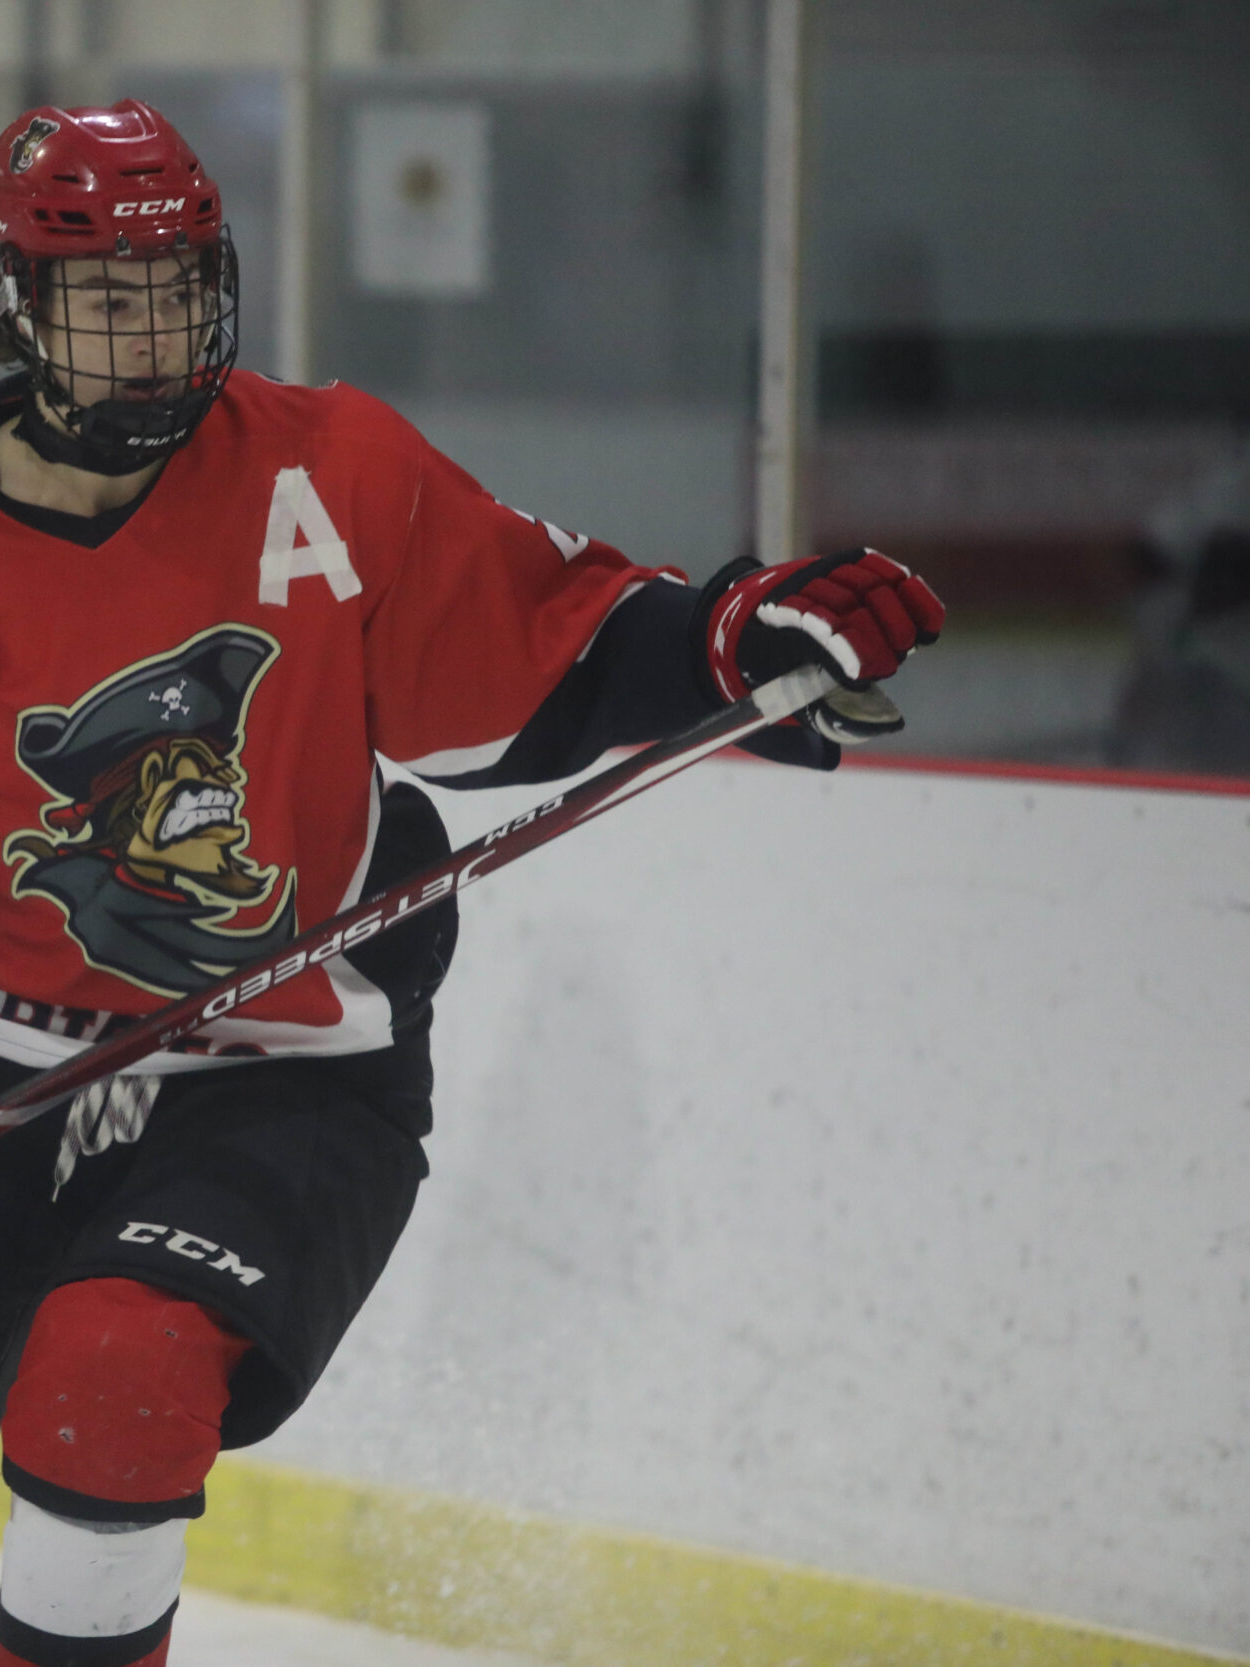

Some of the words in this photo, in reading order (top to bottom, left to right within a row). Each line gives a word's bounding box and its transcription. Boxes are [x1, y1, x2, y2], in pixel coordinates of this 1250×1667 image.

[113, 197, 186, 218] CCM
[258, 464, 363, 608] A
[483, 793, 565, 848] CCM
[202, 848, 496, 1019] JETSPEED
[118, 1221, 266, 1287] CCM
